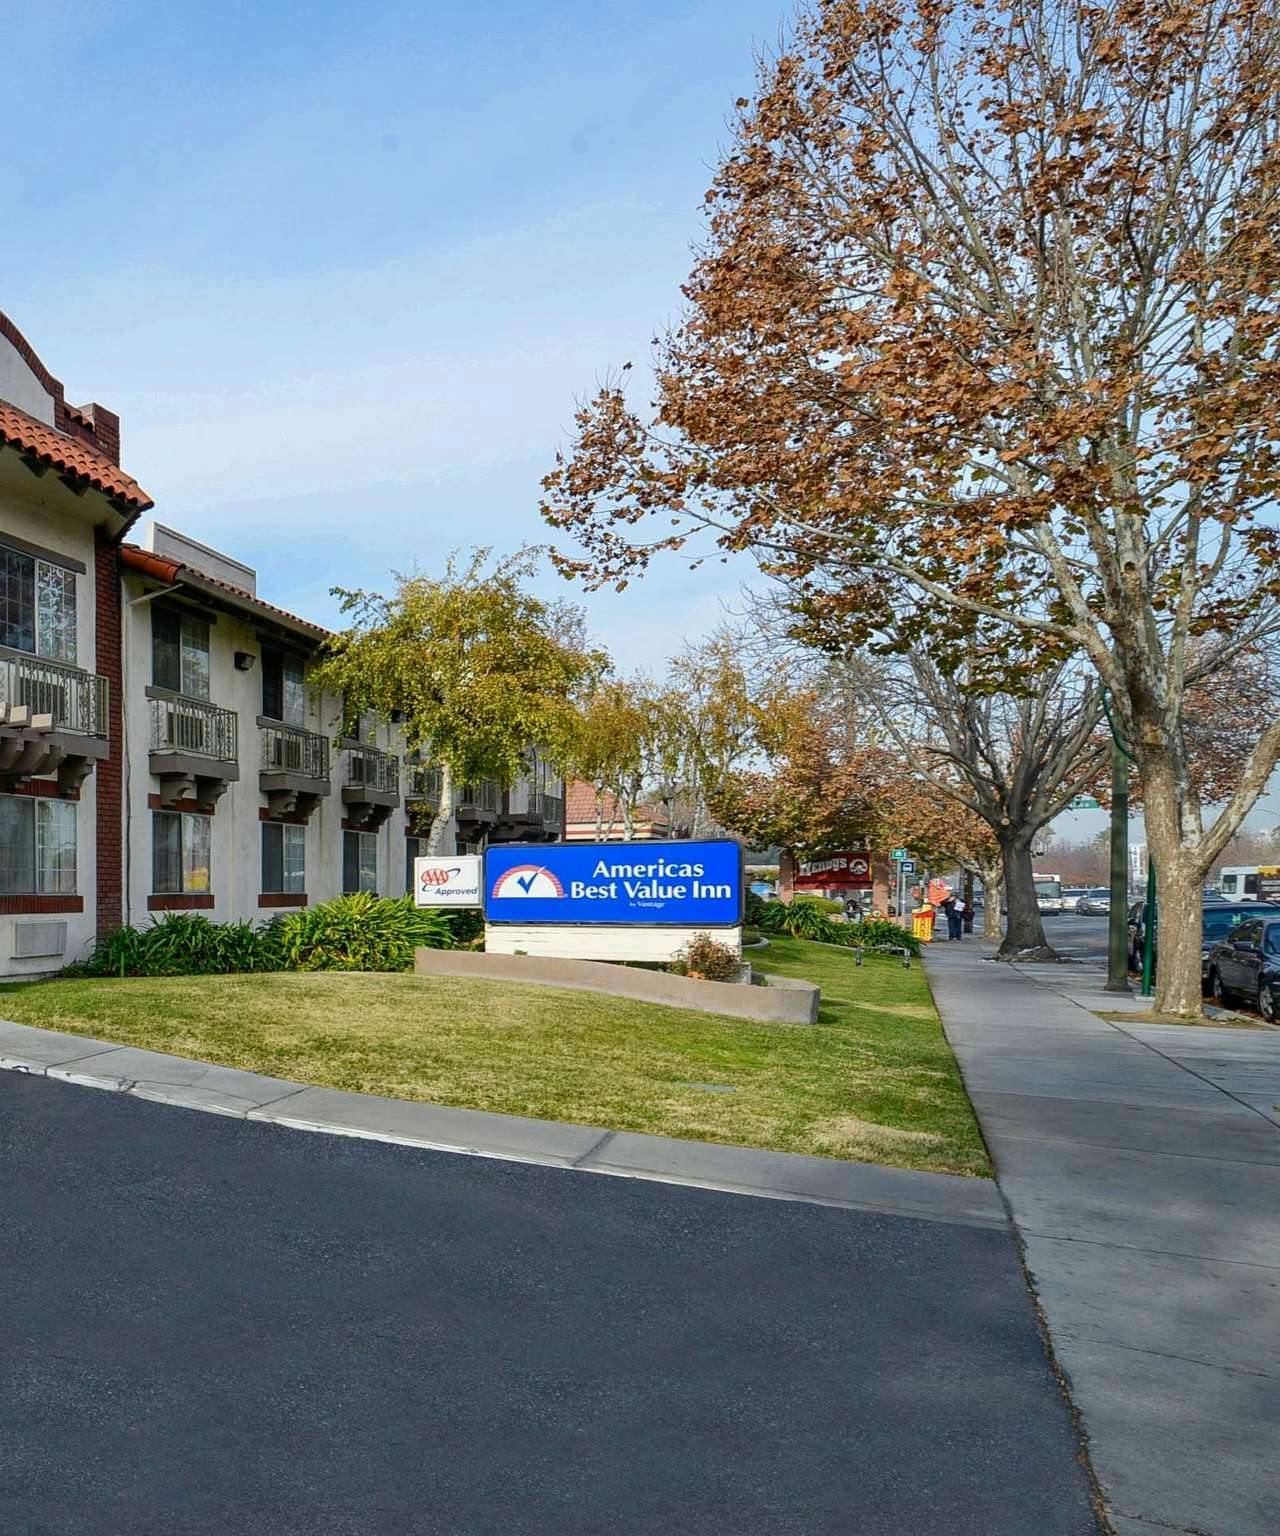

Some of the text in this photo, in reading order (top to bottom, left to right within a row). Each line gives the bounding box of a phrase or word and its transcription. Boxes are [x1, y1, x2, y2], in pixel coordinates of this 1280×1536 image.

[592, 858, 704, 878] Americas
[422, 869, 448, 885] AAA
[435, 887, 478, 897] Approved
[570, 879, 731, 899] Best Value Inn
[637, 901, 665, 909] Vantage
